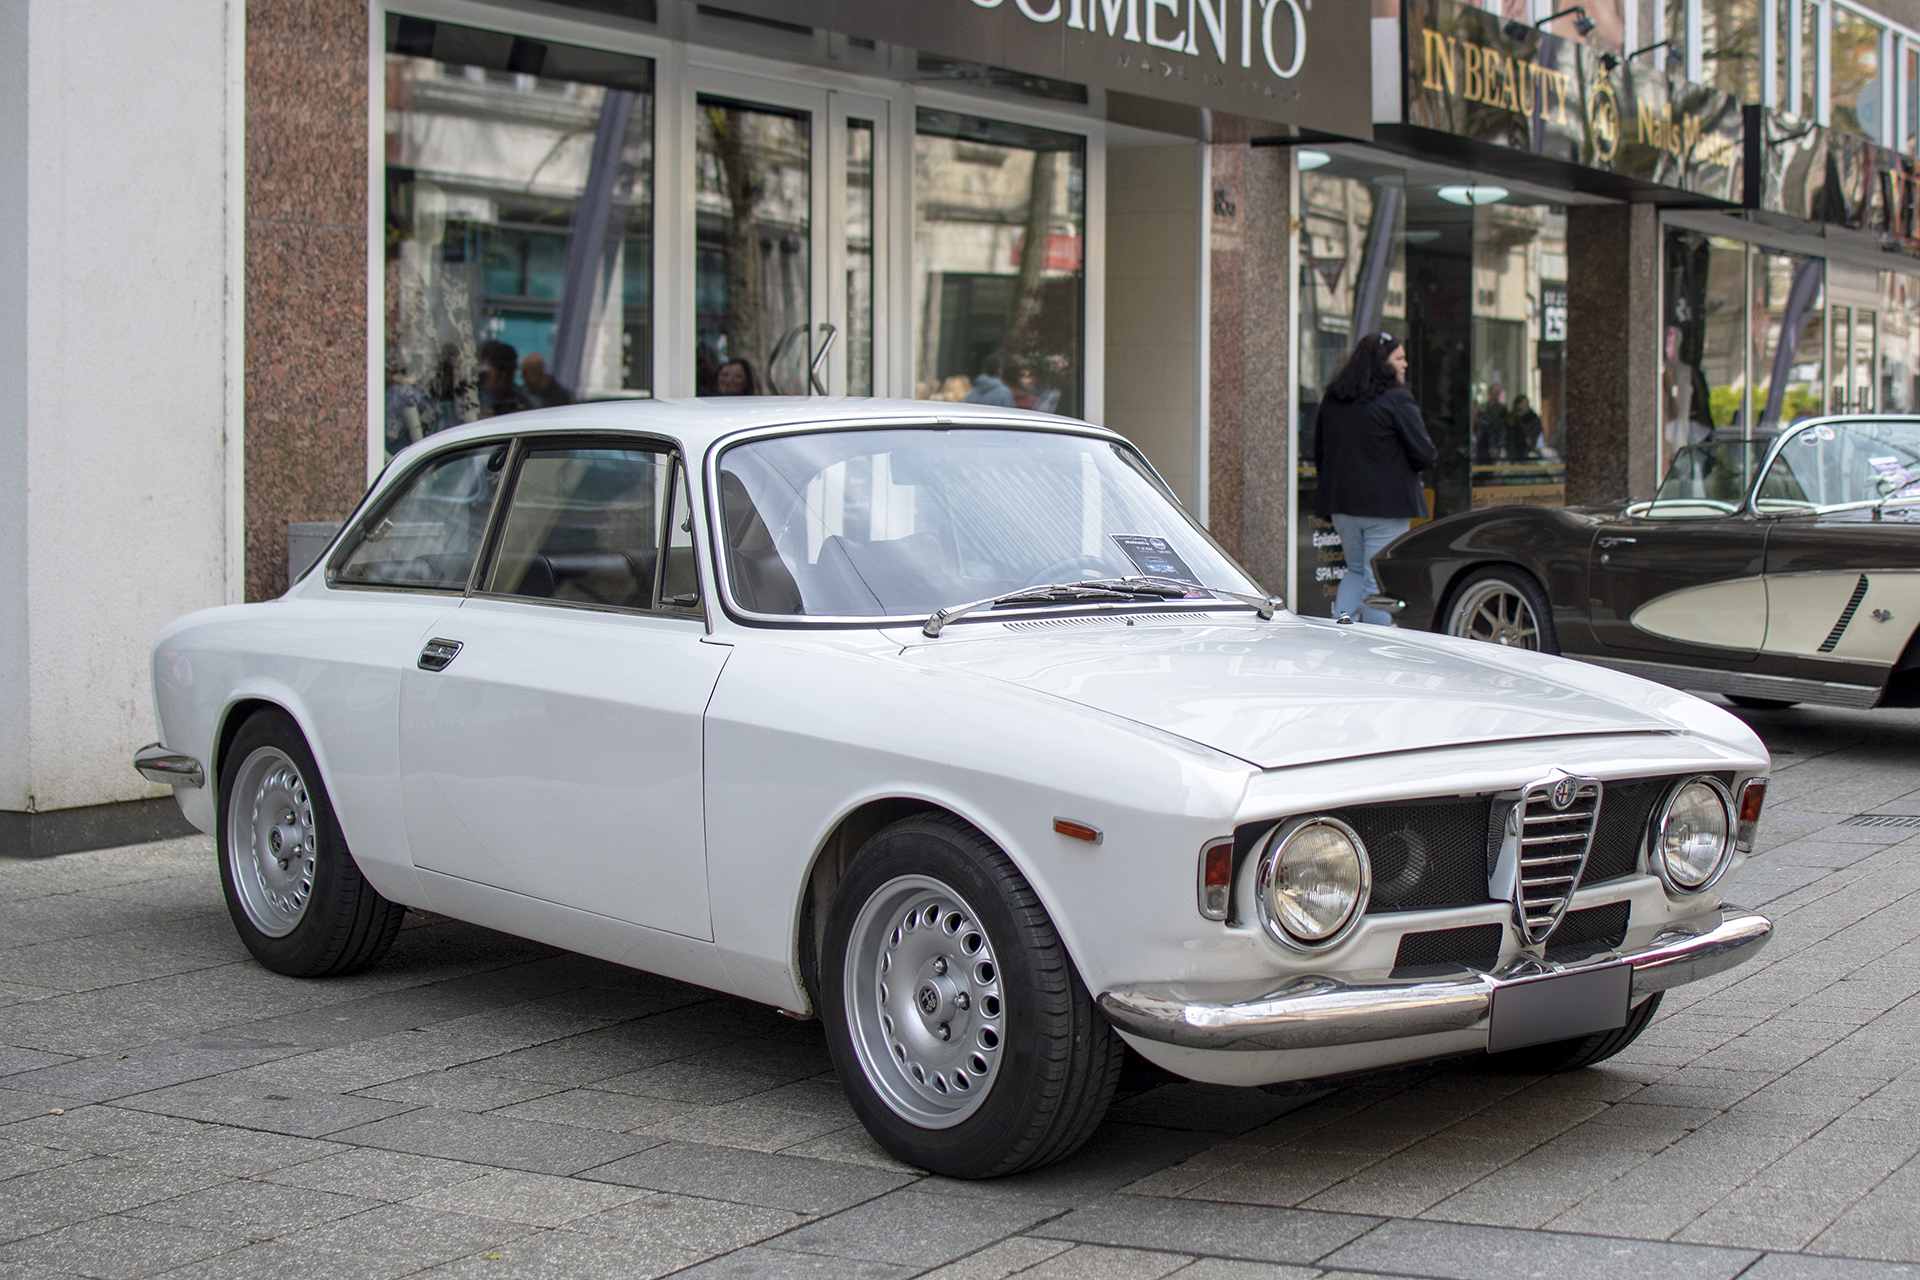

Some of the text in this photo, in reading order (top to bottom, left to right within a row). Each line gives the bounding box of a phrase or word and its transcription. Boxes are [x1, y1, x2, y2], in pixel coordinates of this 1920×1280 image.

[1422, 28, 1570, 126] IN BEAUTY
[1638, 97, 1681, 155] Nails
[1316, 567, 1331, 581] SPA
